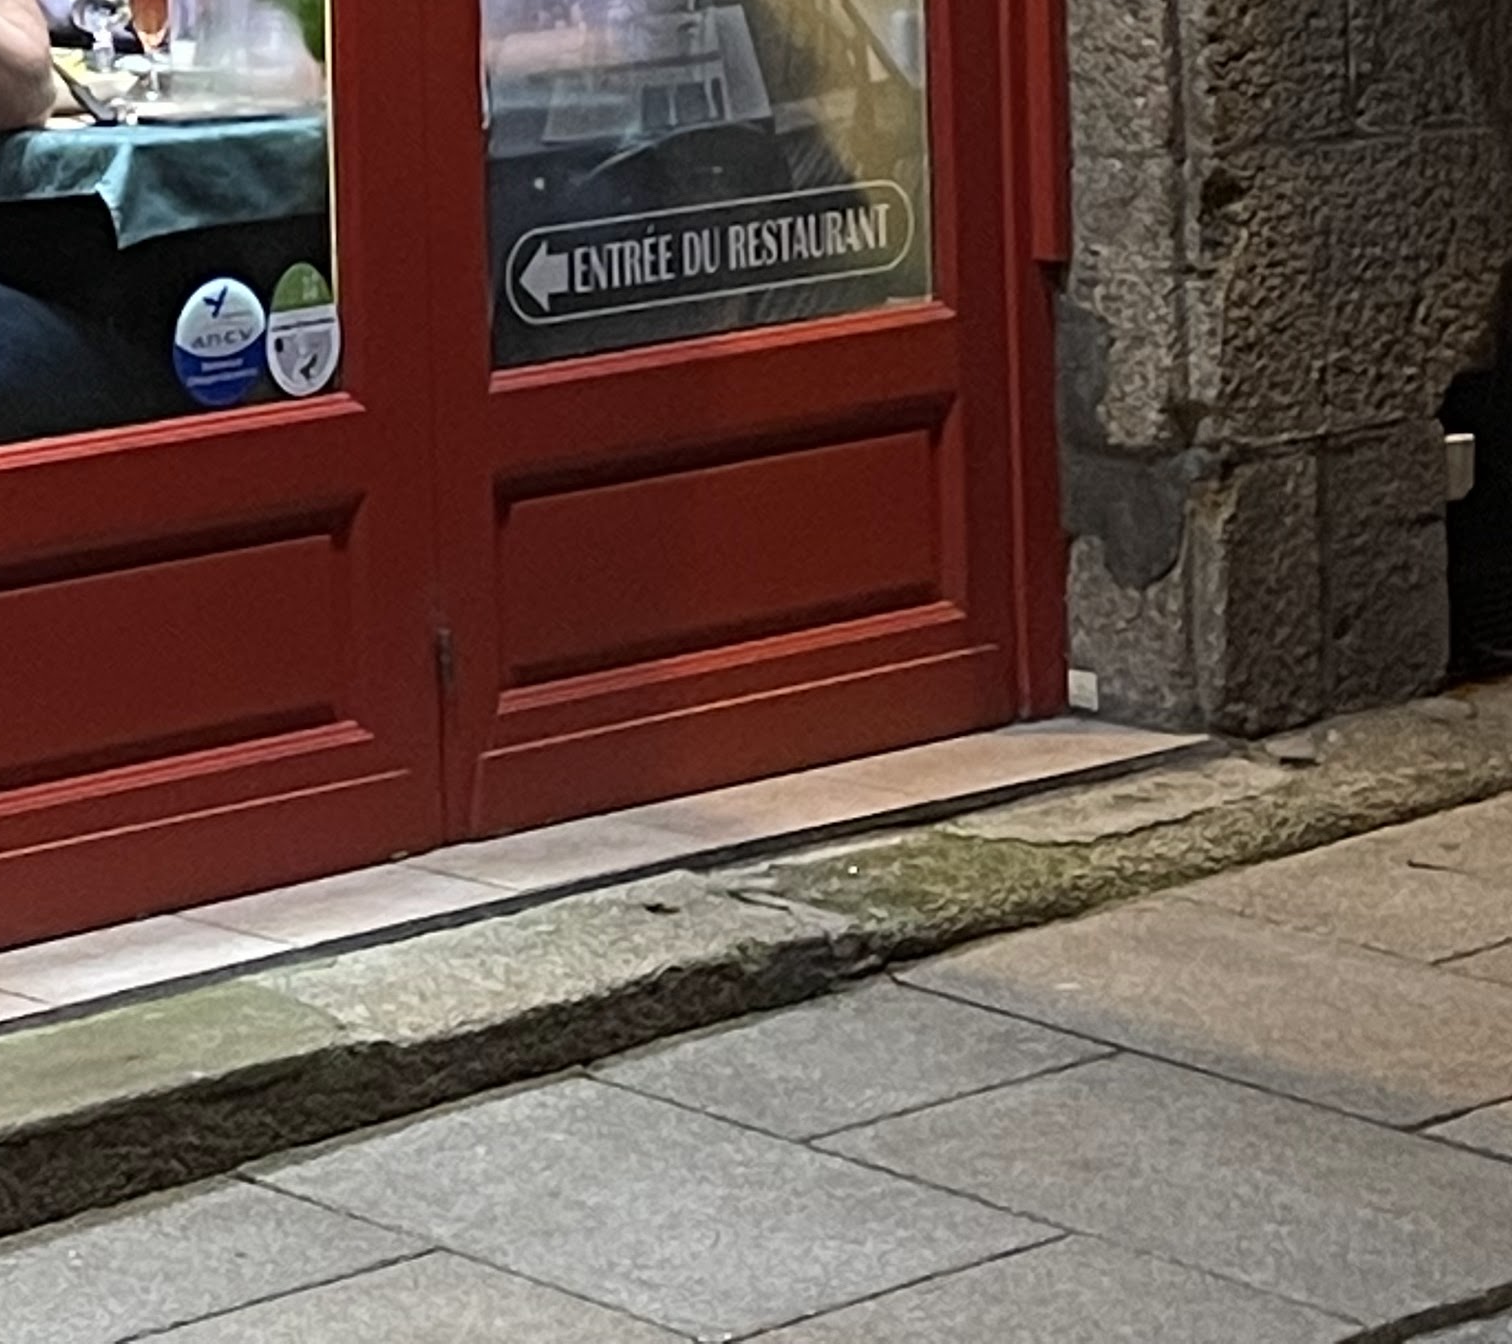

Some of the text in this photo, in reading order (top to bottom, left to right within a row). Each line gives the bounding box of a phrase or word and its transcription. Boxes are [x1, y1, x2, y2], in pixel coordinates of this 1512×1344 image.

[573, 202, 892, 294] ENTRÉE DU RESTAURANT
